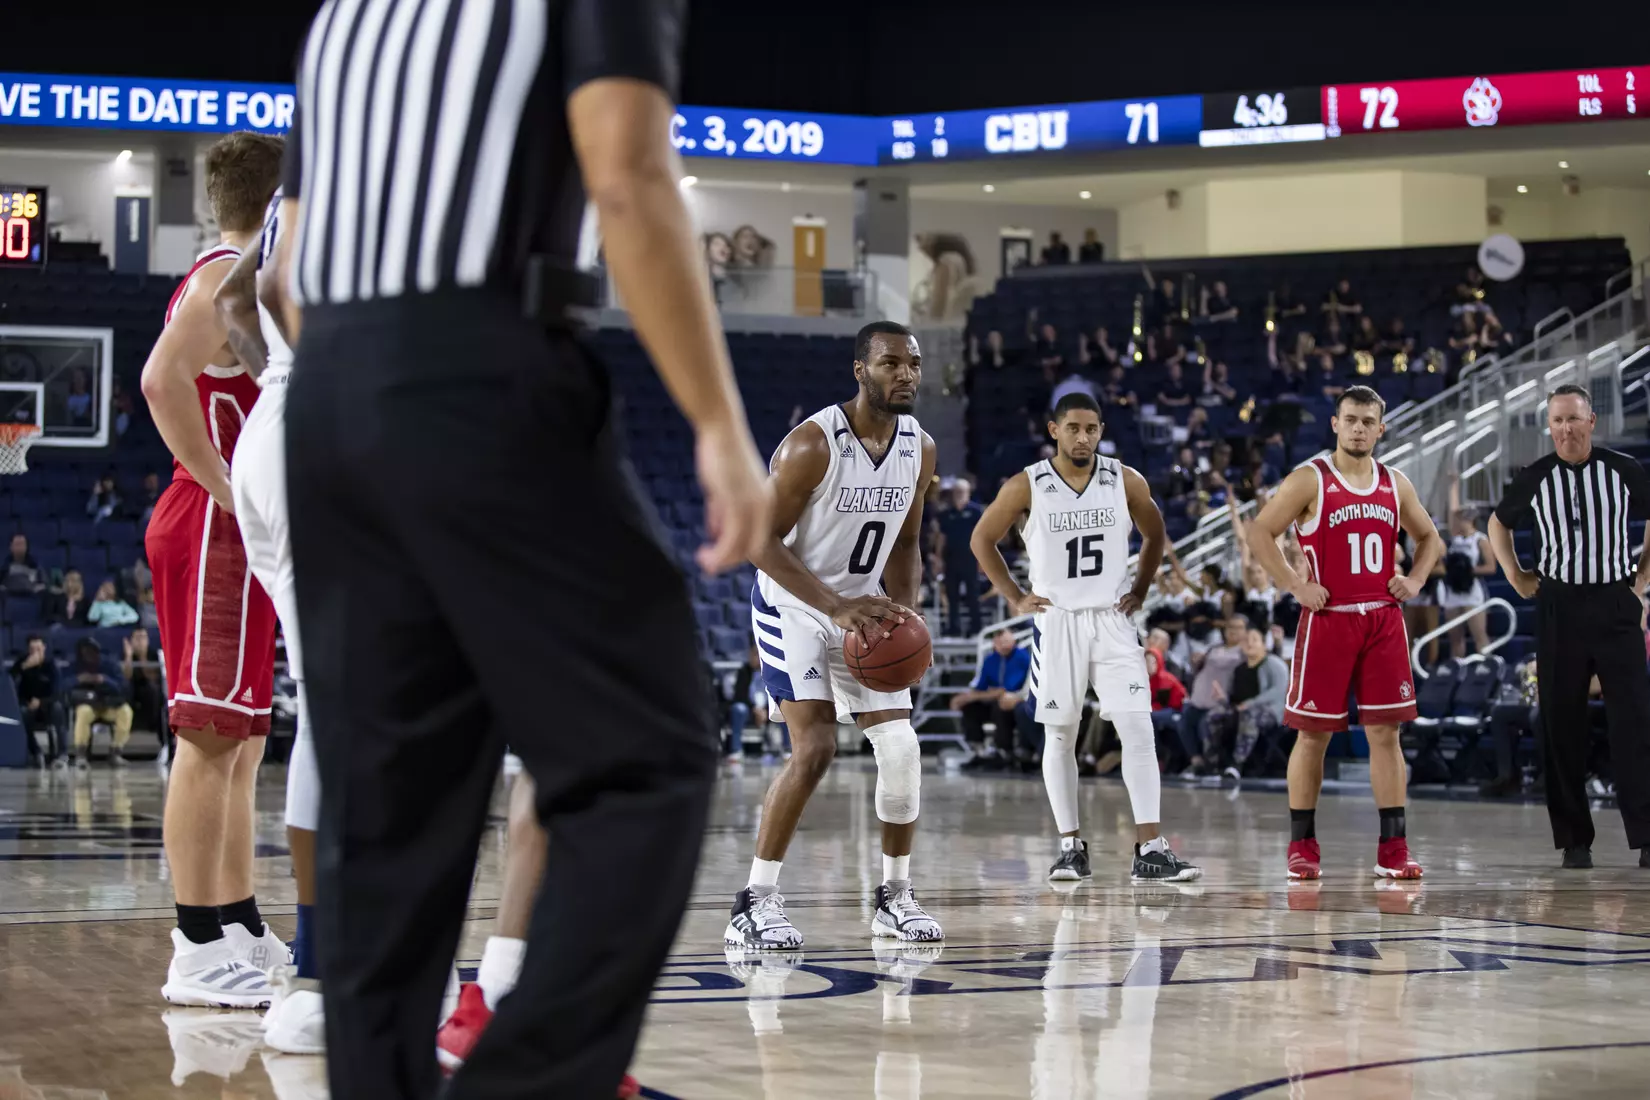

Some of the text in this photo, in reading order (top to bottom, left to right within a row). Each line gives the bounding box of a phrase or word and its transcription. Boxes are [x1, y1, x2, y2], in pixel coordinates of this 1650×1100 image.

[1625, 71, 1635, 90] 2
[50, 84, 120, 121] THE
[129, 87, 219, 125] DATE
[225, 91, 294, 128] FOR
[1125, 102, 1159, 144] 71
[1360, 87, 1399, 130] 72
[1626, 94, 1636, 114] 5
[703, 115, 737, 156] 3,
[742, 117, 824, 157] 2019
[985, 109, 1069, 153] CBU
[0, 192, 38, 218] :36
[899, 449, 914, 458] WAC
[836, 486, 910, 513] LANCERS
[1048, 507, 1116, 532] LANCERS
[1329, 503, 1395, 528] SOUTH DAKOTA
[848, 520, 886, 575] 0
[1065, 533, 1104, 579] 15
[1347, 532, 1384, 575] 10
